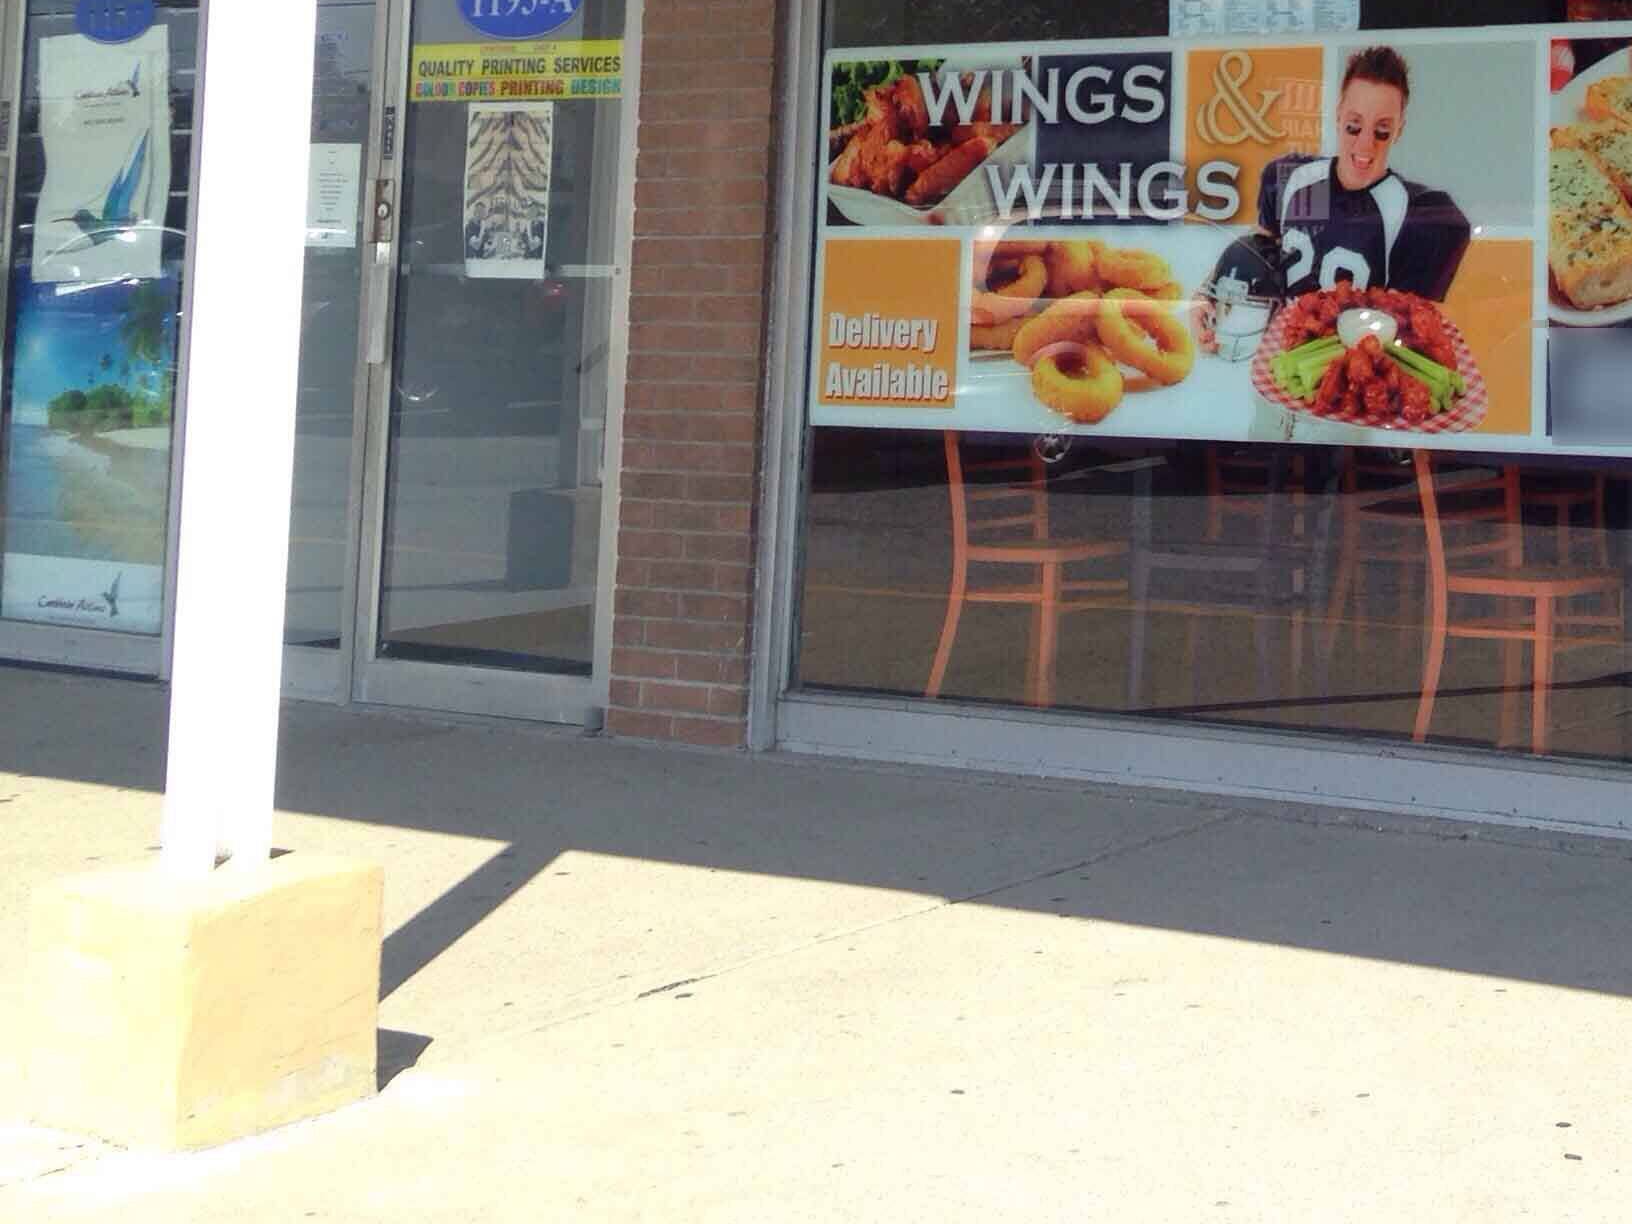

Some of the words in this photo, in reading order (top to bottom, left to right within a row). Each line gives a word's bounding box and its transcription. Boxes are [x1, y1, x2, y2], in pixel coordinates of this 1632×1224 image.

[419, 59, 474, 77] QUALITY
[481, 57, 545, 75] PRINTING
[554, 56, 621, 74] SERVICES
[916, 65, 1167, 126] WINGS
[1196, 50, 1290, 145] &
[985, 160, 1241, 222] WINGS
[828, 312, 938, 354] Delivery
[824, 361, 950, 402] Available
